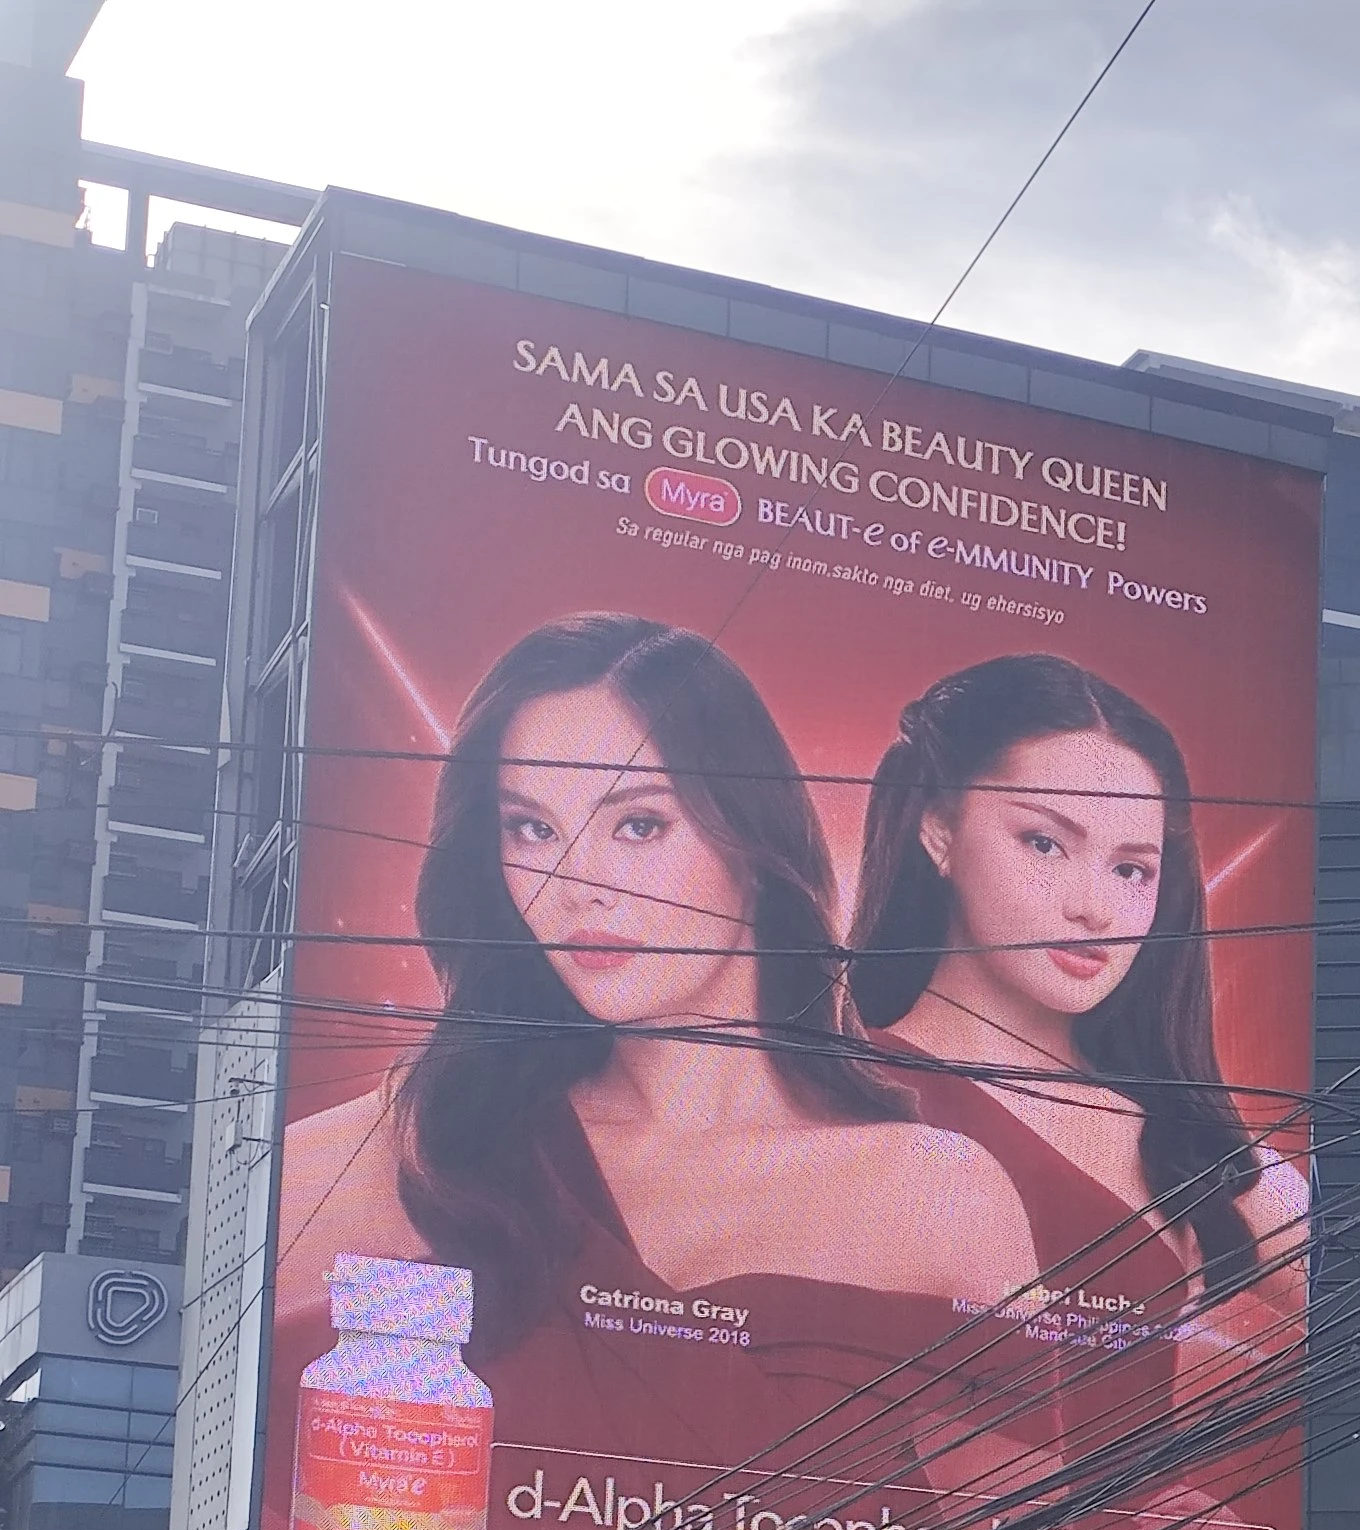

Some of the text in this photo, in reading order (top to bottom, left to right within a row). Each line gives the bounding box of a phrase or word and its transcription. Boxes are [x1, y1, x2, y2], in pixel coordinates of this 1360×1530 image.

[513, 340, 1168, 512] SAMA SA USA KA BEAUTY QUEEN
[554, 403, 1127, 552] ANG GLOWING CONFIDENCE!
[467, 436, 590, 485] Tungod
[596, 469, 632, 495] sa
[661, 478, 727, 513] Myra
[890, 530, 923, 555] of
[1107, 571, 1208, 615] Powers
[616, 516, 639, 537] Sa
[644, 526, 709, 551] regular
[713, 540, 744, 561] nga
[750, 548, 782, 569] pag
[883, 574, 914, 597] nga
[960, 590, 982, 612] ug
[987, 594, 1065, 625] ehersisyo
[580, 1284, 751, 1328] Catriona Gray
[584, 1311, 751, 1347] Miss Universe 2018
[952, 1299, 990, 1318] Mis
[995, 1303, 1061, 1328] Univrse
[1066, 1313, 1151, 1338] Philppines
